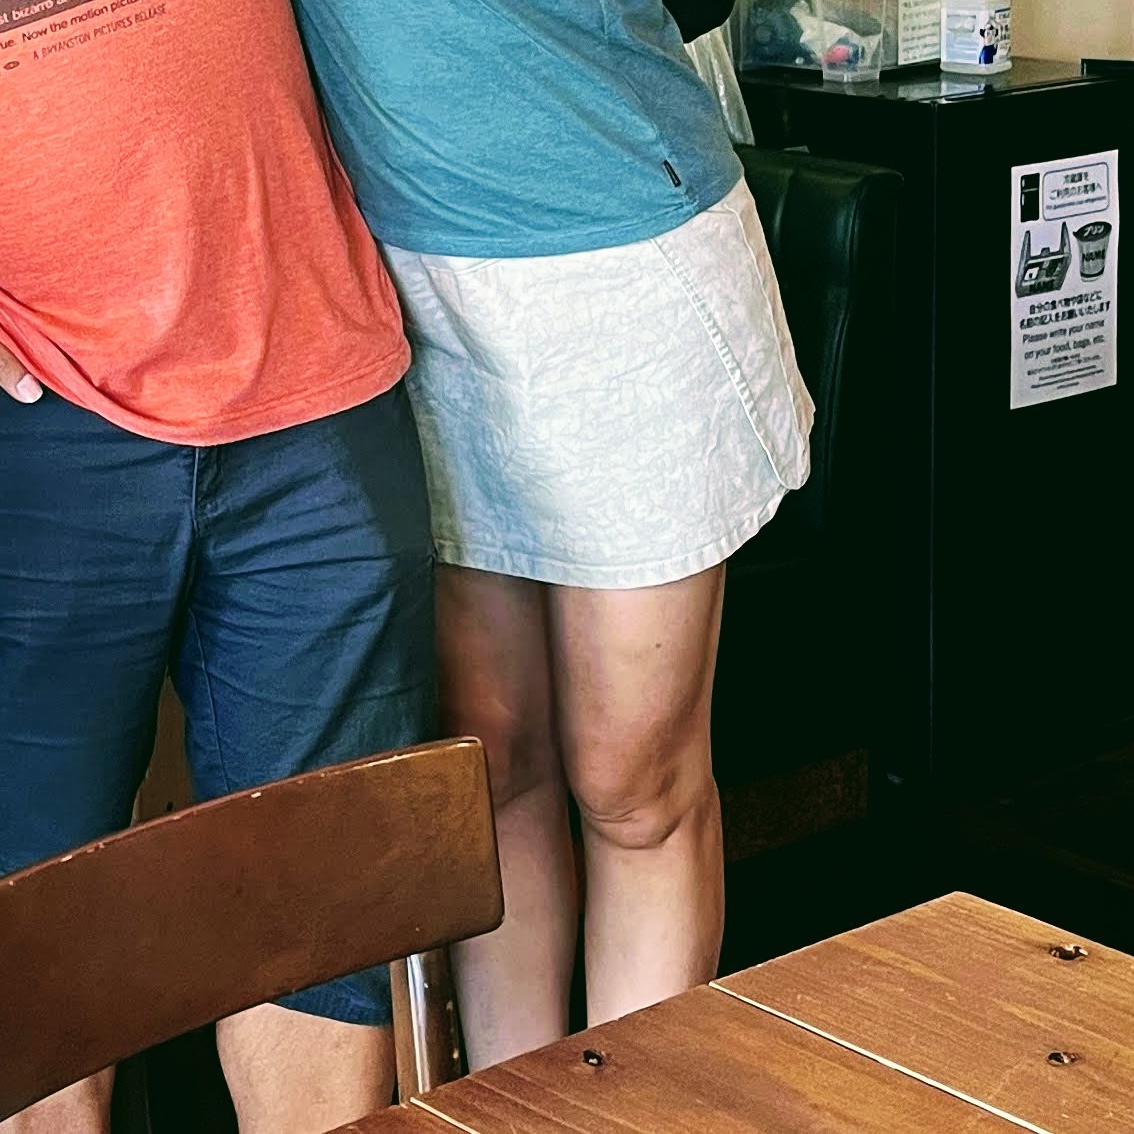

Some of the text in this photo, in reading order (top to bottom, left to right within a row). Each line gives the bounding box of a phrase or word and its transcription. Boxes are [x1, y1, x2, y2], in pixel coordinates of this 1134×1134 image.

[20, 26, 49, 44] Now
[49, 16, 69, 33] the
[69, 4, 109, 26] motion
[93, 15, 134, 38] PICTURES
